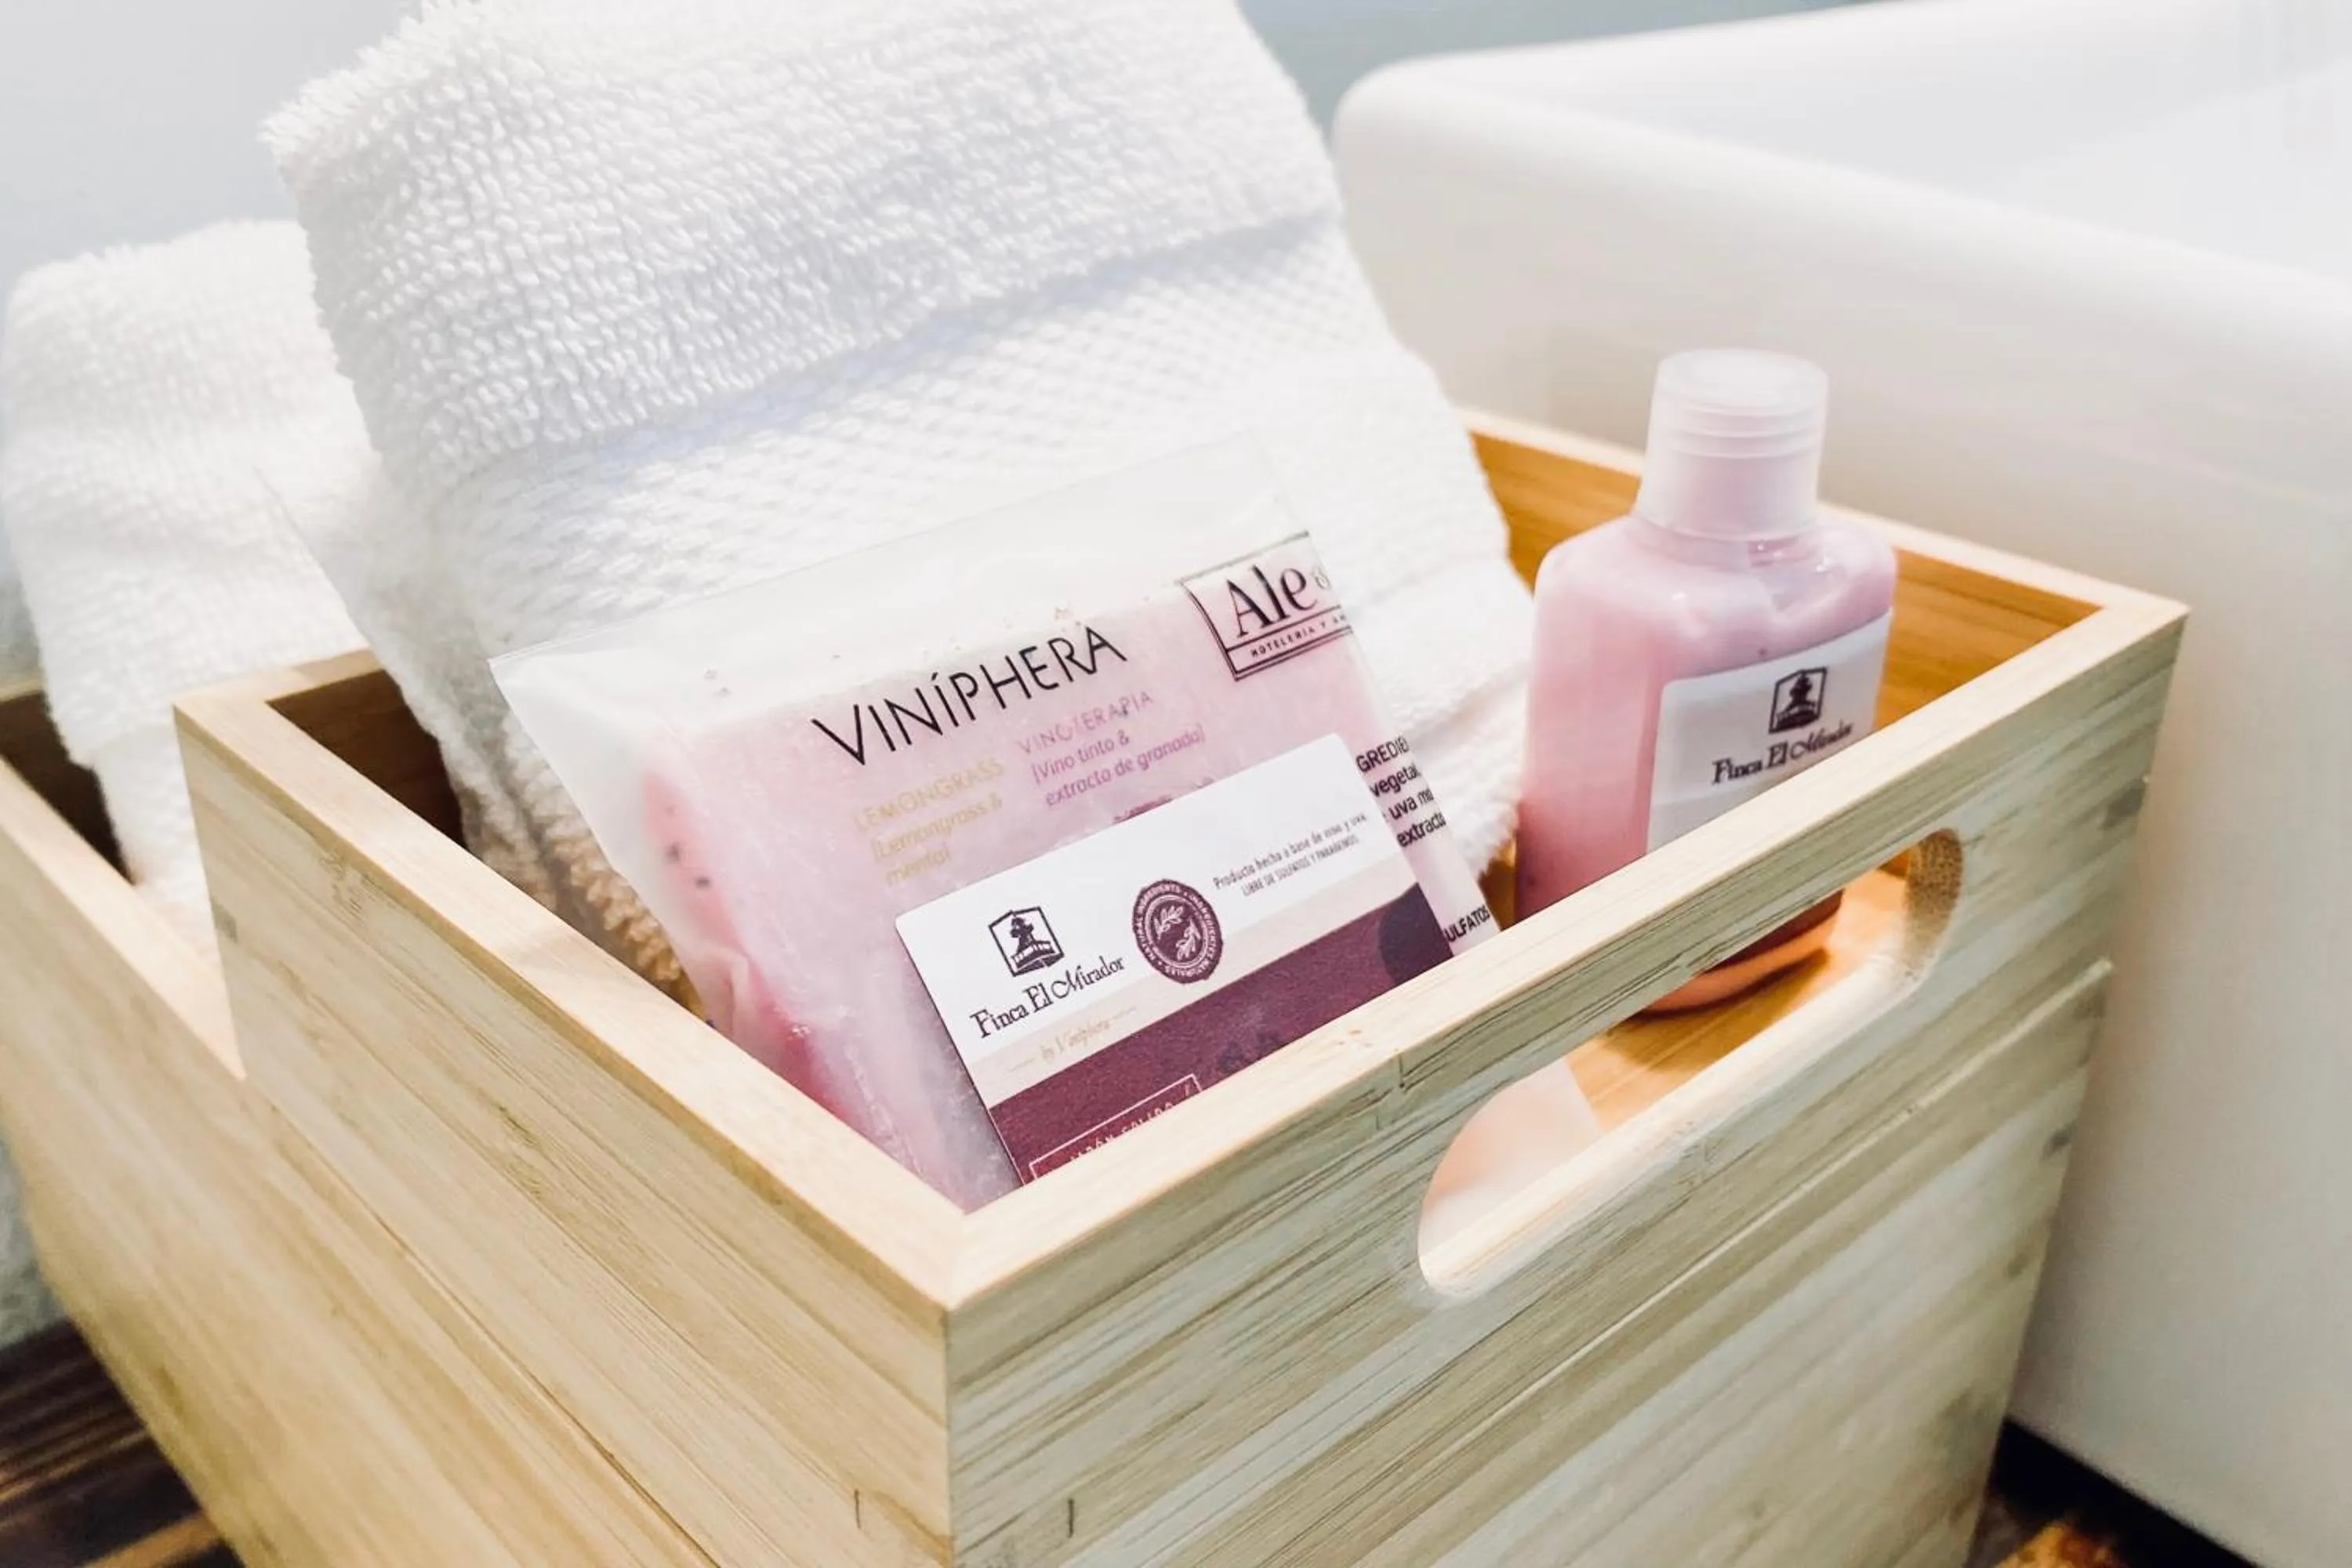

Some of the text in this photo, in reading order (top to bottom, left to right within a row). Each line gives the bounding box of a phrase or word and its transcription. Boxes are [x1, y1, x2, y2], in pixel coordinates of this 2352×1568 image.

[1226, 564, 1318, 639] Ale
[811, 626, 1127, 766] VINÍPHERA
[1017, 689, 1153, 754] VINOTERAPIA
[1077, 738, 1116, 764] tinto
[1116, 728, 1130, 746] &
[1711, 757, 1764, 785] Finca
[1766, 740, 1789, 769] El
[1045, 767, 1112, 807] extracto
[1114, 757, 1134, 777] de
[1388, 797, 1417, 820] uva
[969, 954, 1125, 1039] Finca El Mirador
